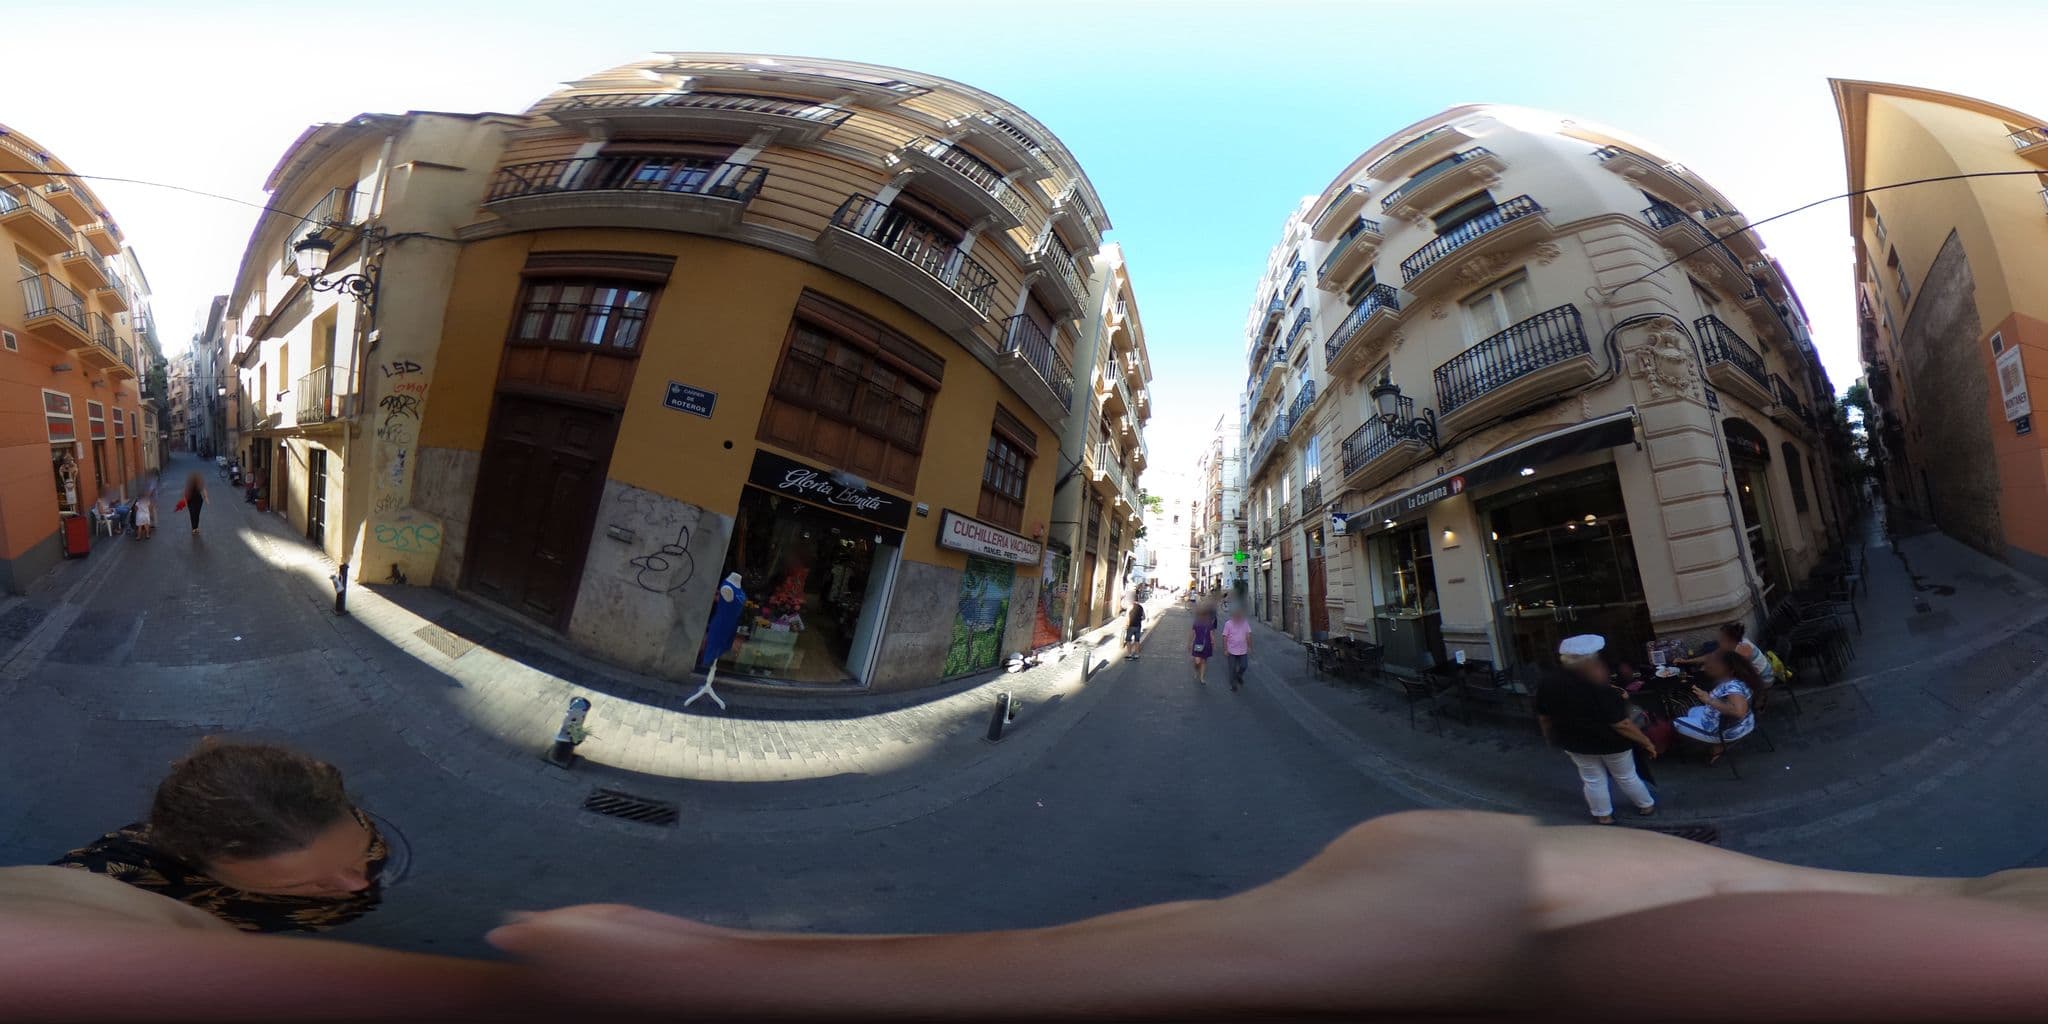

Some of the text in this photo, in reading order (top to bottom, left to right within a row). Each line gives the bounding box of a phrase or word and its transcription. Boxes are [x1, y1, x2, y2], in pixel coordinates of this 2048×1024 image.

[671, 399, 706, 413] ROTEROS
[778, 469, 892, 510] Gloria Bonita
[1408, 497, 1416, 509] La
[953, 520, 1009, 549] CUCHILLERIA
[983, 545, 1002, 556] MANUEL
